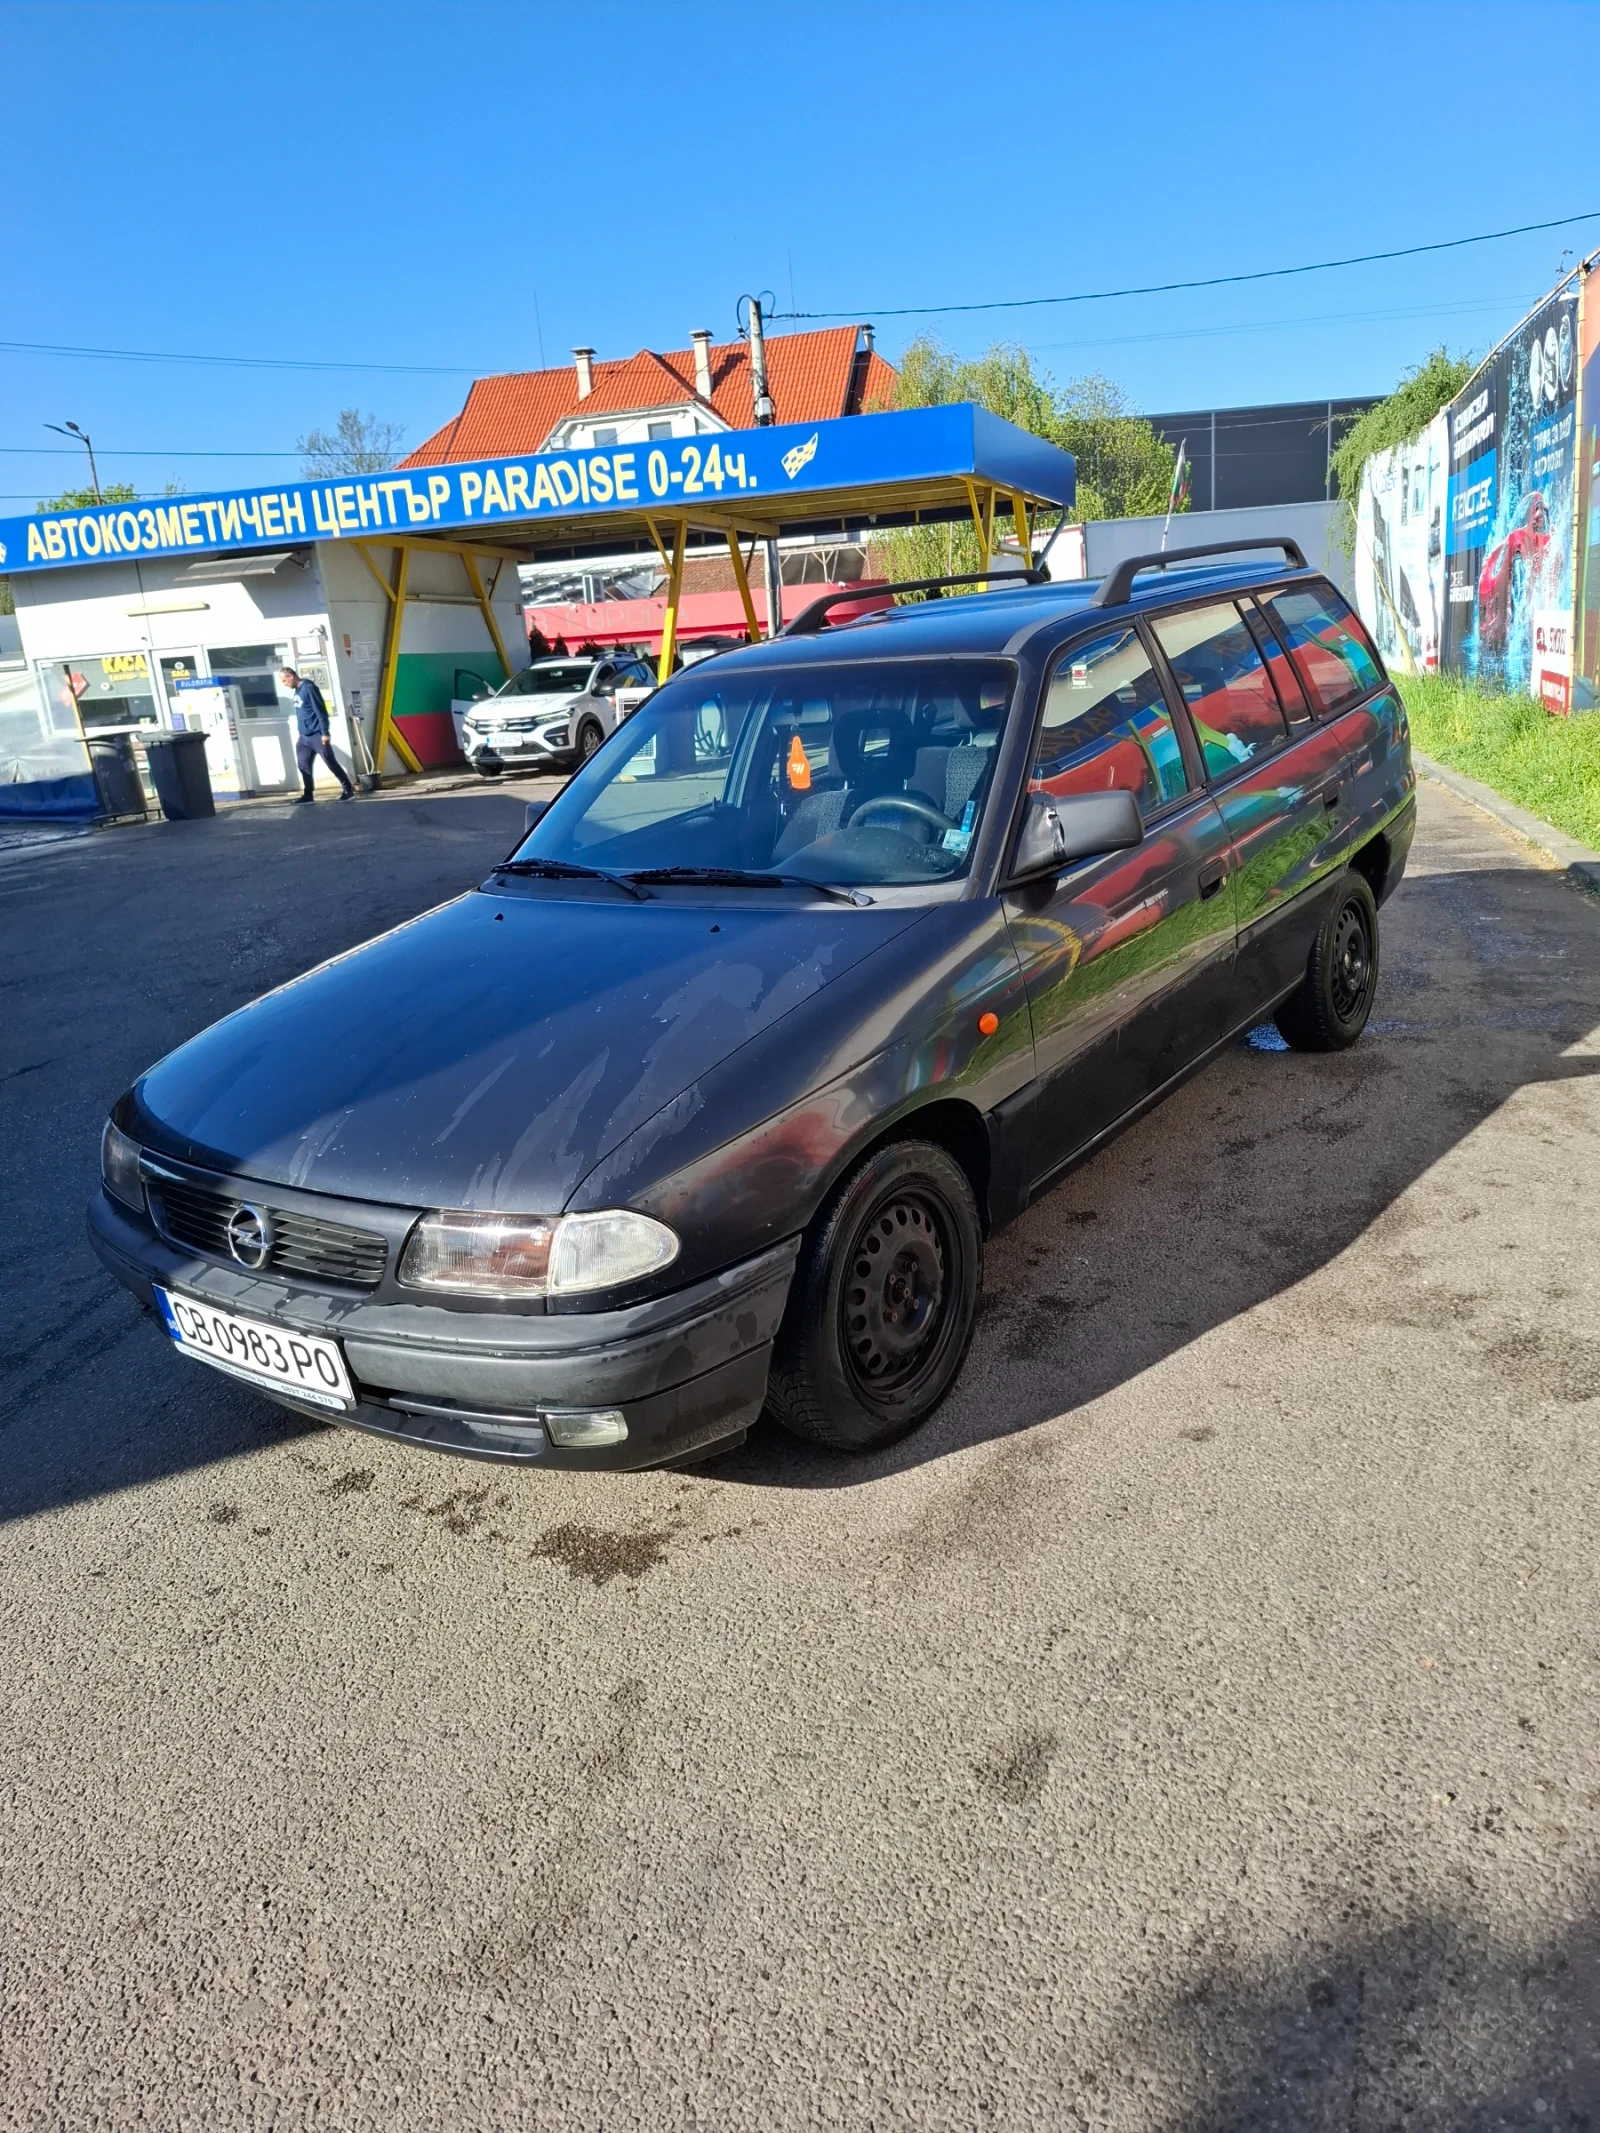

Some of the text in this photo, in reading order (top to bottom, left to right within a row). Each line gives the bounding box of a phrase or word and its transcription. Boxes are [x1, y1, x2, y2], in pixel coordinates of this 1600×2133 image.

[27, 443, 757, 562] АВТОКОЗМЕТИЧЕН ЦЕНТЪР PARADISE 0-24ч.
[101, 654, 147, 674] КАСА
